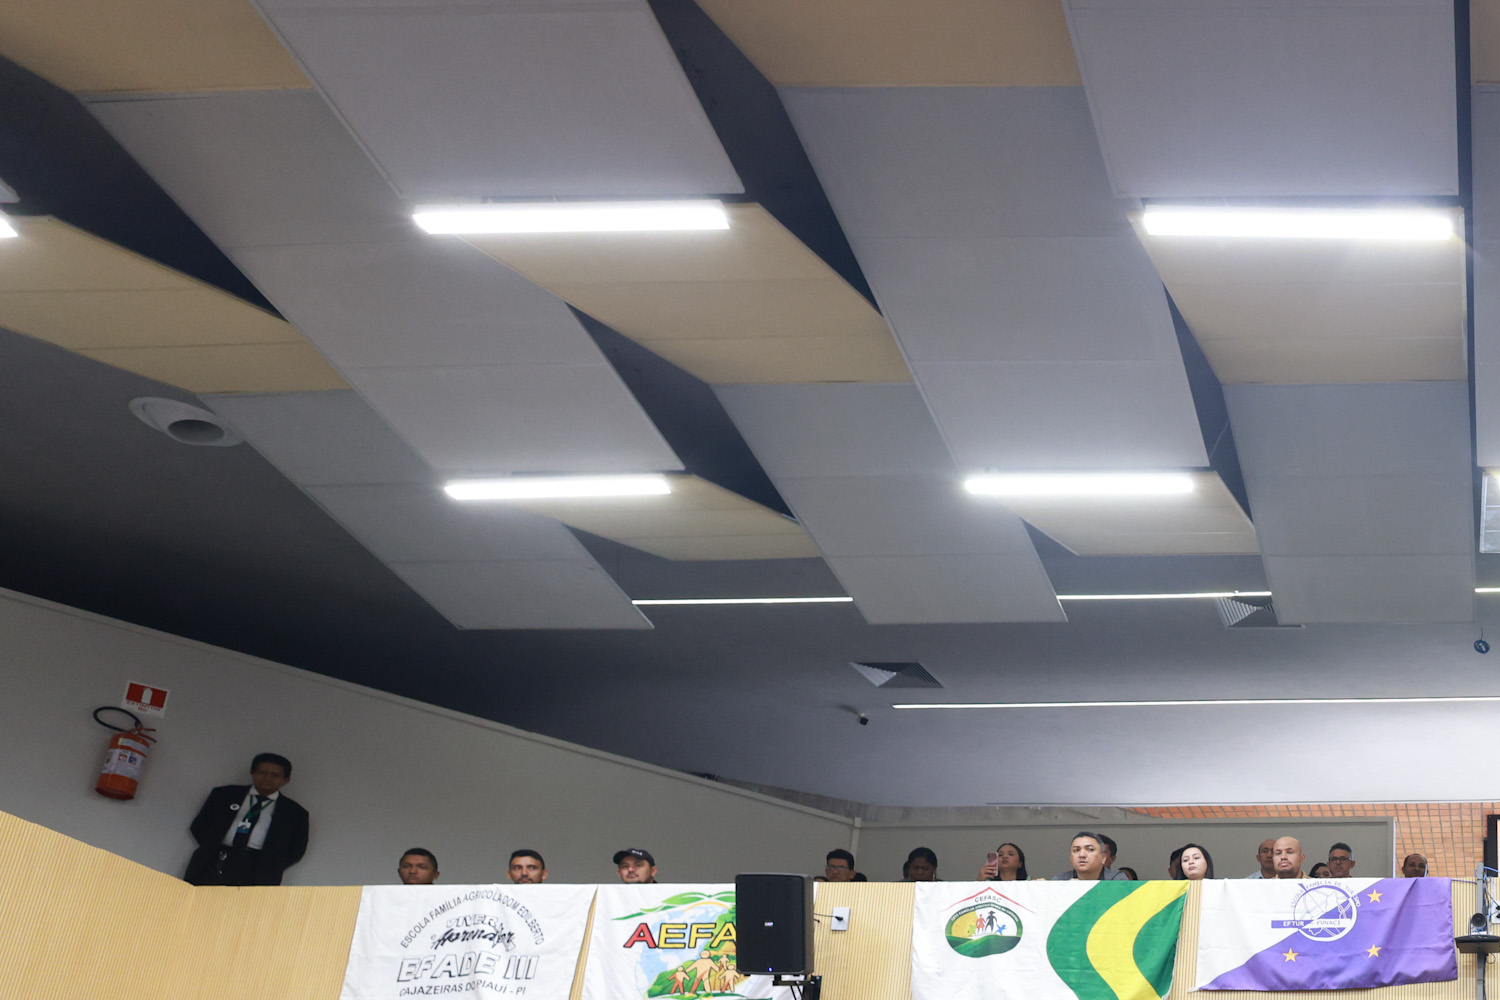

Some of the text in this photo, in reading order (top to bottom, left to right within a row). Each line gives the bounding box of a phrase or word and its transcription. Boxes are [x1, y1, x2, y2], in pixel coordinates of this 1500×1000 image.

[974, 895, 1002, 903] CEFASC
[400, 917, 430, 949] ESCOLA
[516, 905, 545, 946] EDILBERTO
[397, 951, 540, 982] EFADE III
[399, 983, 463, 996] CAJAZEIRAS
[465, 981, 475, 992] DO
[516, 986, 526, 995] PI
